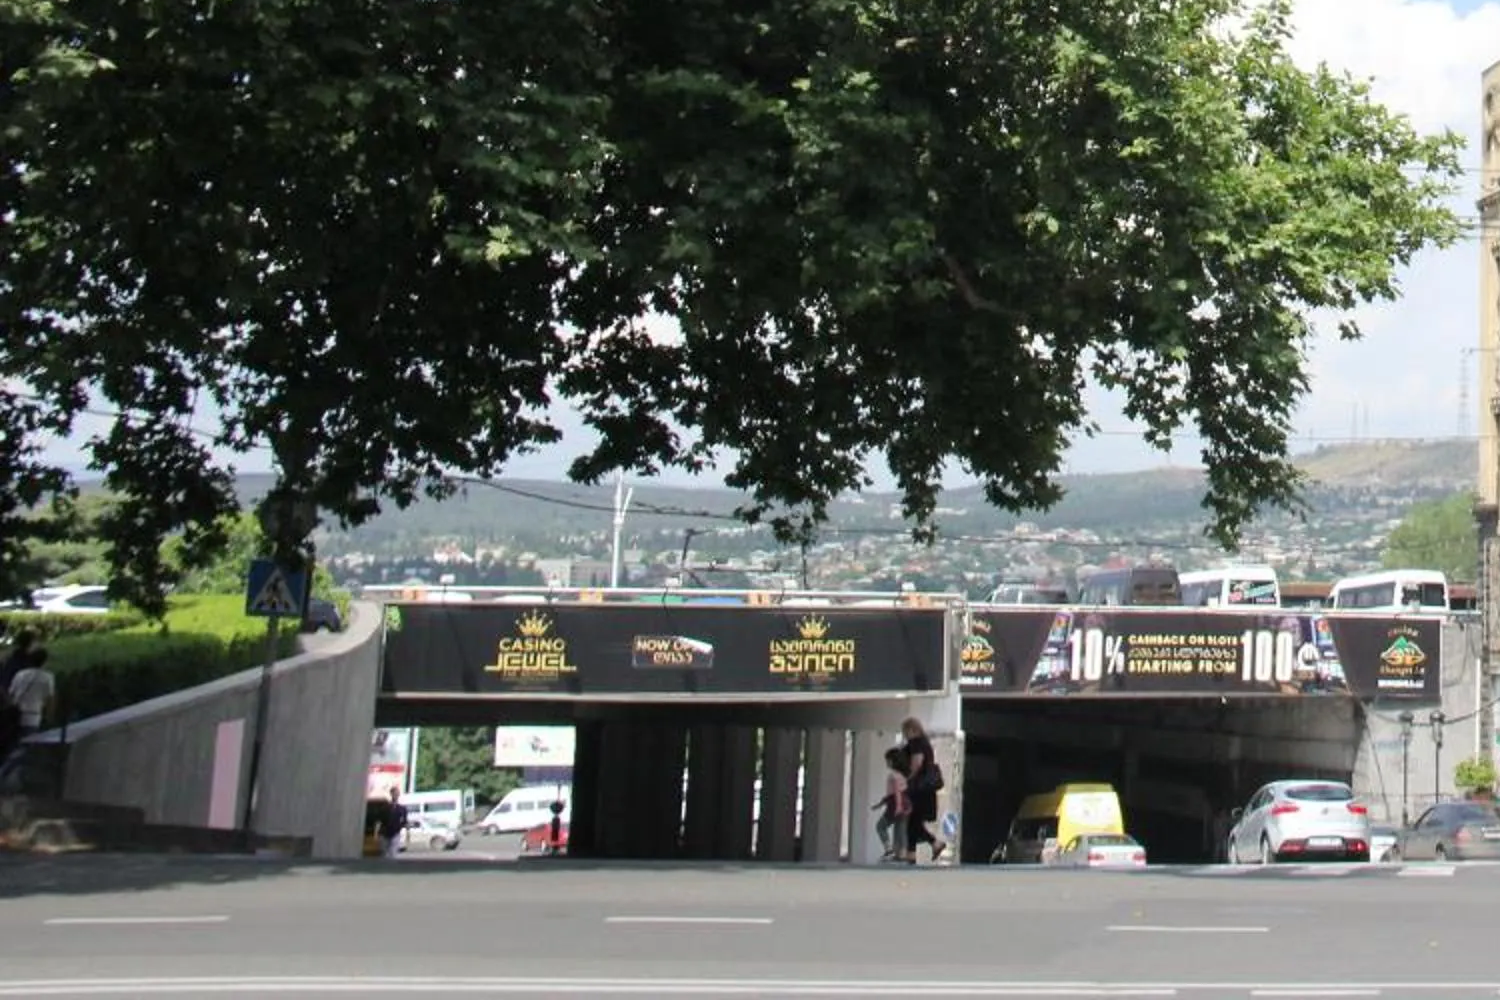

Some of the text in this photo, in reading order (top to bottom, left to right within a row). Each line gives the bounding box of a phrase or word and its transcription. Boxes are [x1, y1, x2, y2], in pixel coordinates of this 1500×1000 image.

[499, 637, 565, 652] CASINO
[1127, 635, 1238, 645] CASHBACK ON SLOTS
[1069, 628, 1125, 680] 10%
[483, 652, 578, 672] JEWEL
[1127, 660, 1237, 673] STARTING FROM
